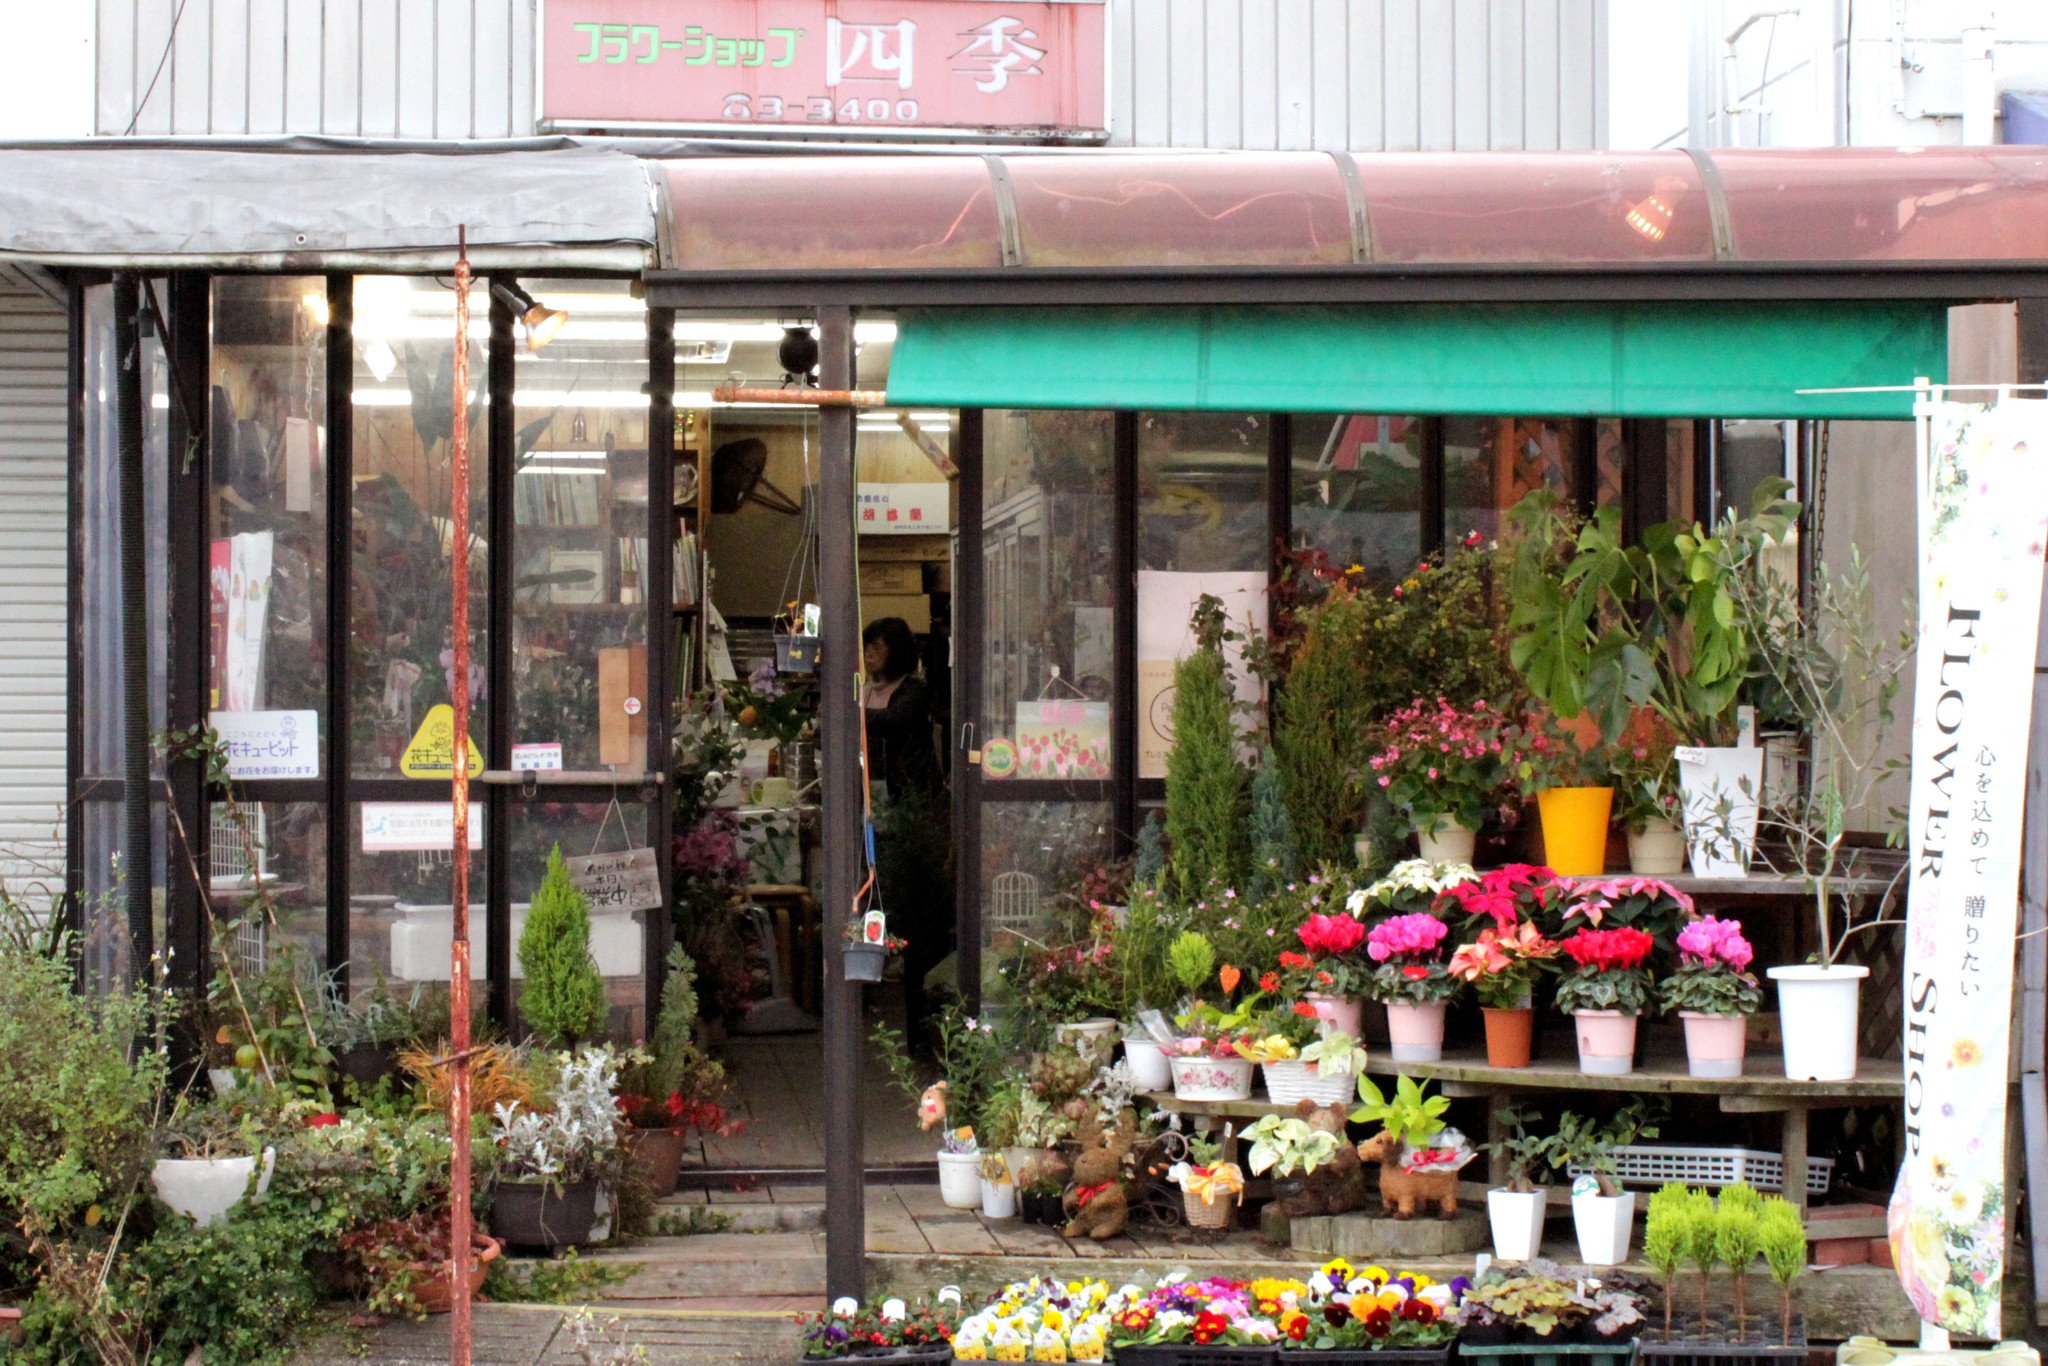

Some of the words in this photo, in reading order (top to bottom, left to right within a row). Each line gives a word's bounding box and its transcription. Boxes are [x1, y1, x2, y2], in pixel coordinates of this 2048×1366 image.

[574, 22, 807, 68] フラワーショップ
[826, 15, 1048, 94] 四季
[757, 94, 919, 121] 3-3400
[223, 766, 315, 775] にお花をお届けします。
[1919, 600, 1981, 879] FLOWER
[1969, 744, 1997, 876] 心を込めて
[1960, 894, 1986, 997] 贈りたい
[1906, 971, 1938, 1157] SHOP
